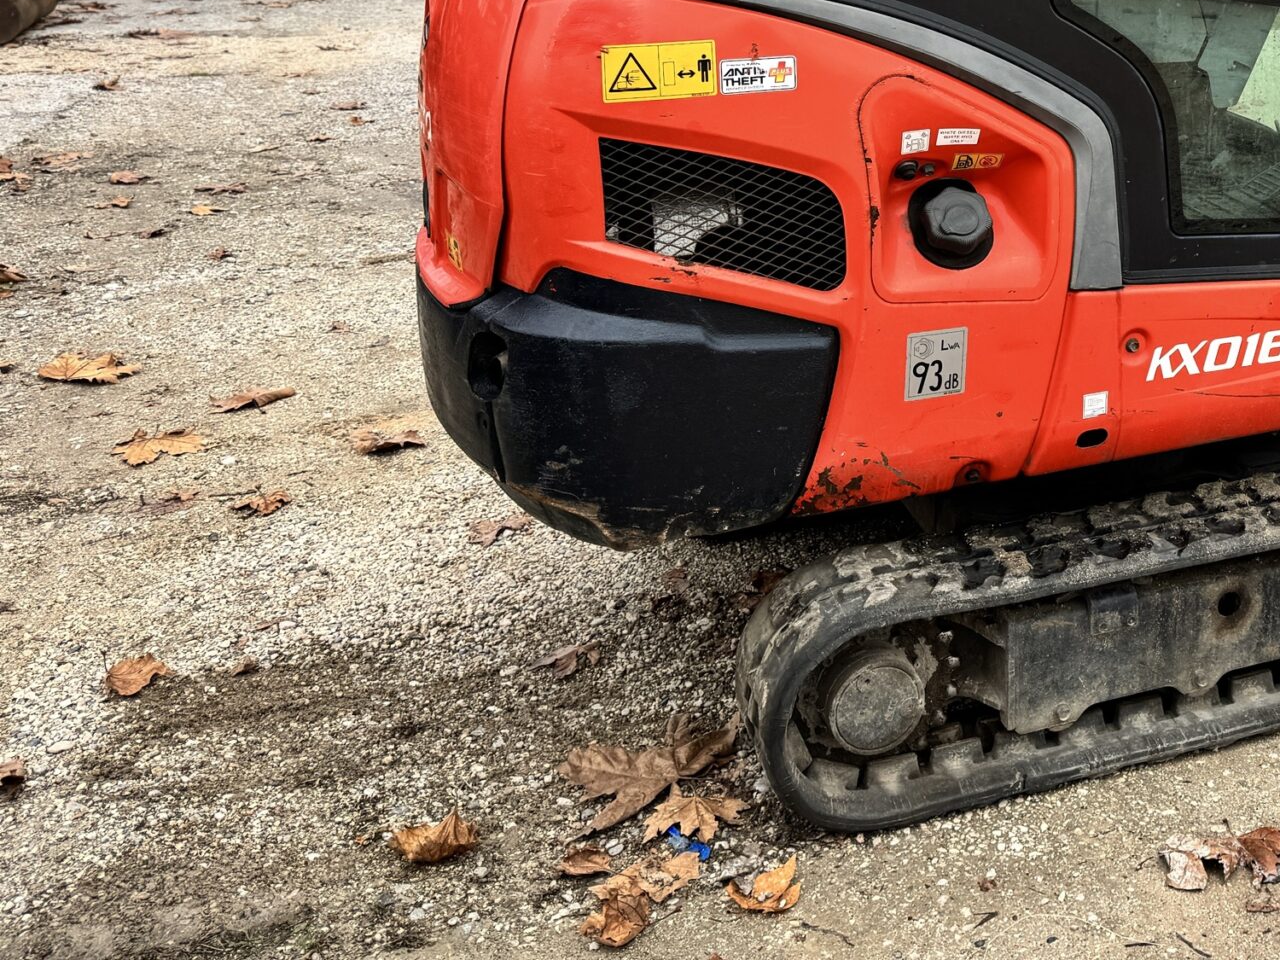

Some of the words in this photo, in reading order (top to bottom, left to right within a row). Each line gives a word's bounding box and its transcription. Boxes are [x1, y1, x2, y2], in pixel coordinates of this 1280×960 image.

[723, 76, 766, 87] THEFT
[912, 359, 943, 394] 93
[944, 373, 959, 389] dB
